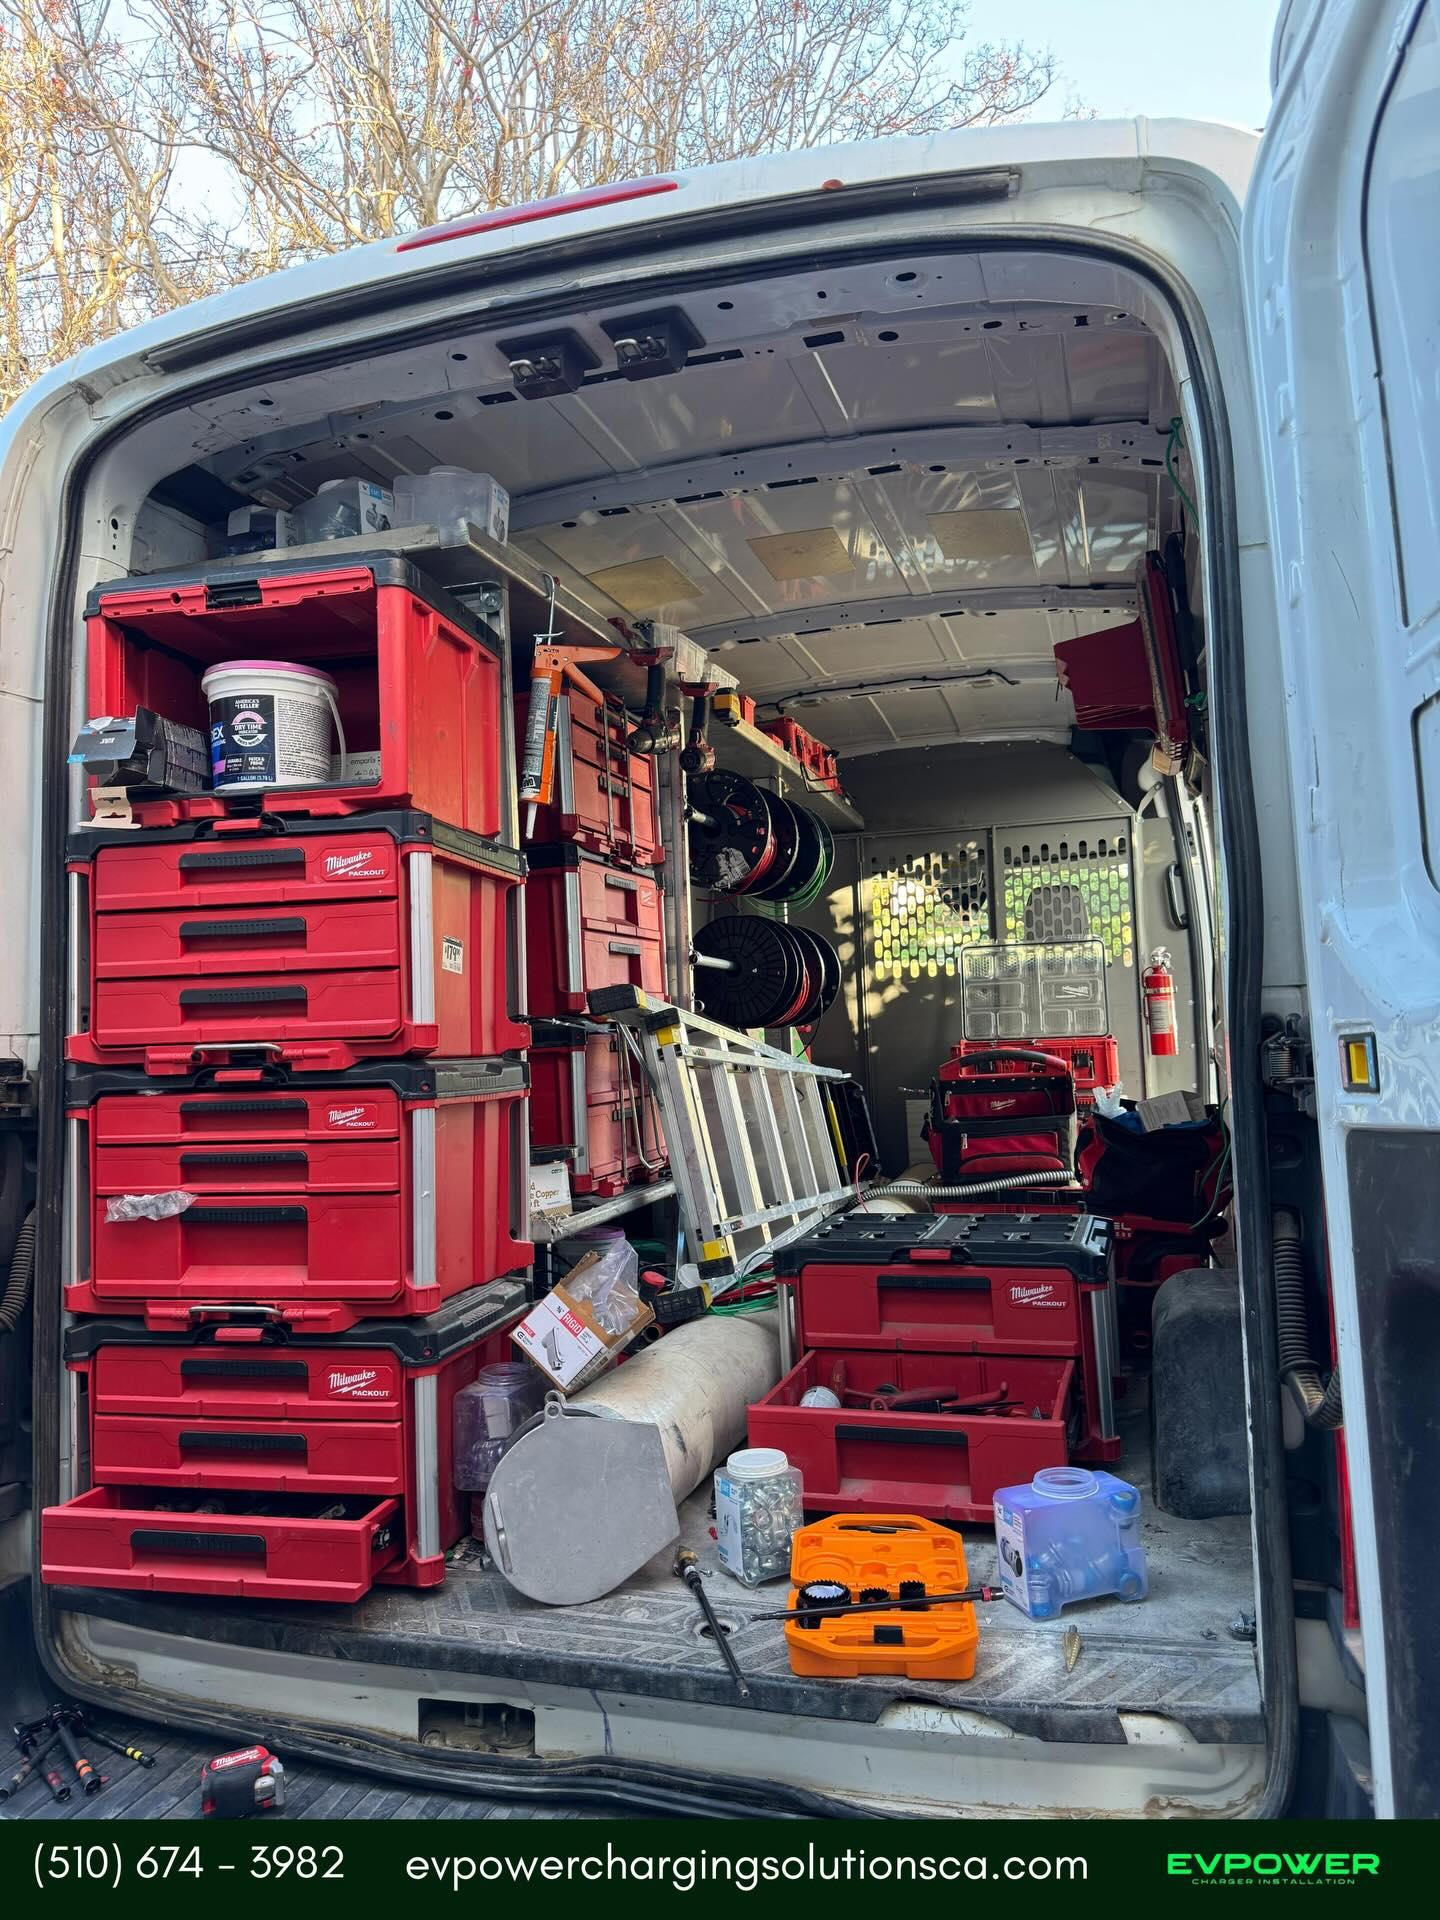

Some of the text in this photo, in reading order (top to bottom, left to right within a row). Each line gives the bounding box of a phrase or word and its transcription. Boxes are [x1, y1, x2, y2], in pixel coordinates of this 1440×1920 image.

[324, 851, 372, 872] Milwaukee
[328, 1107, 365, 1123] Milwaukee
[535, 1190, 560, 1199] Copper
[1009, 1283, 1054, 1300] Milwaukee
[563, 1312, 583, 1334] RIGID
[328, 1369, 377, 1389] Milwaukee
[215, 1749, 260, 1766] Milwaukee
